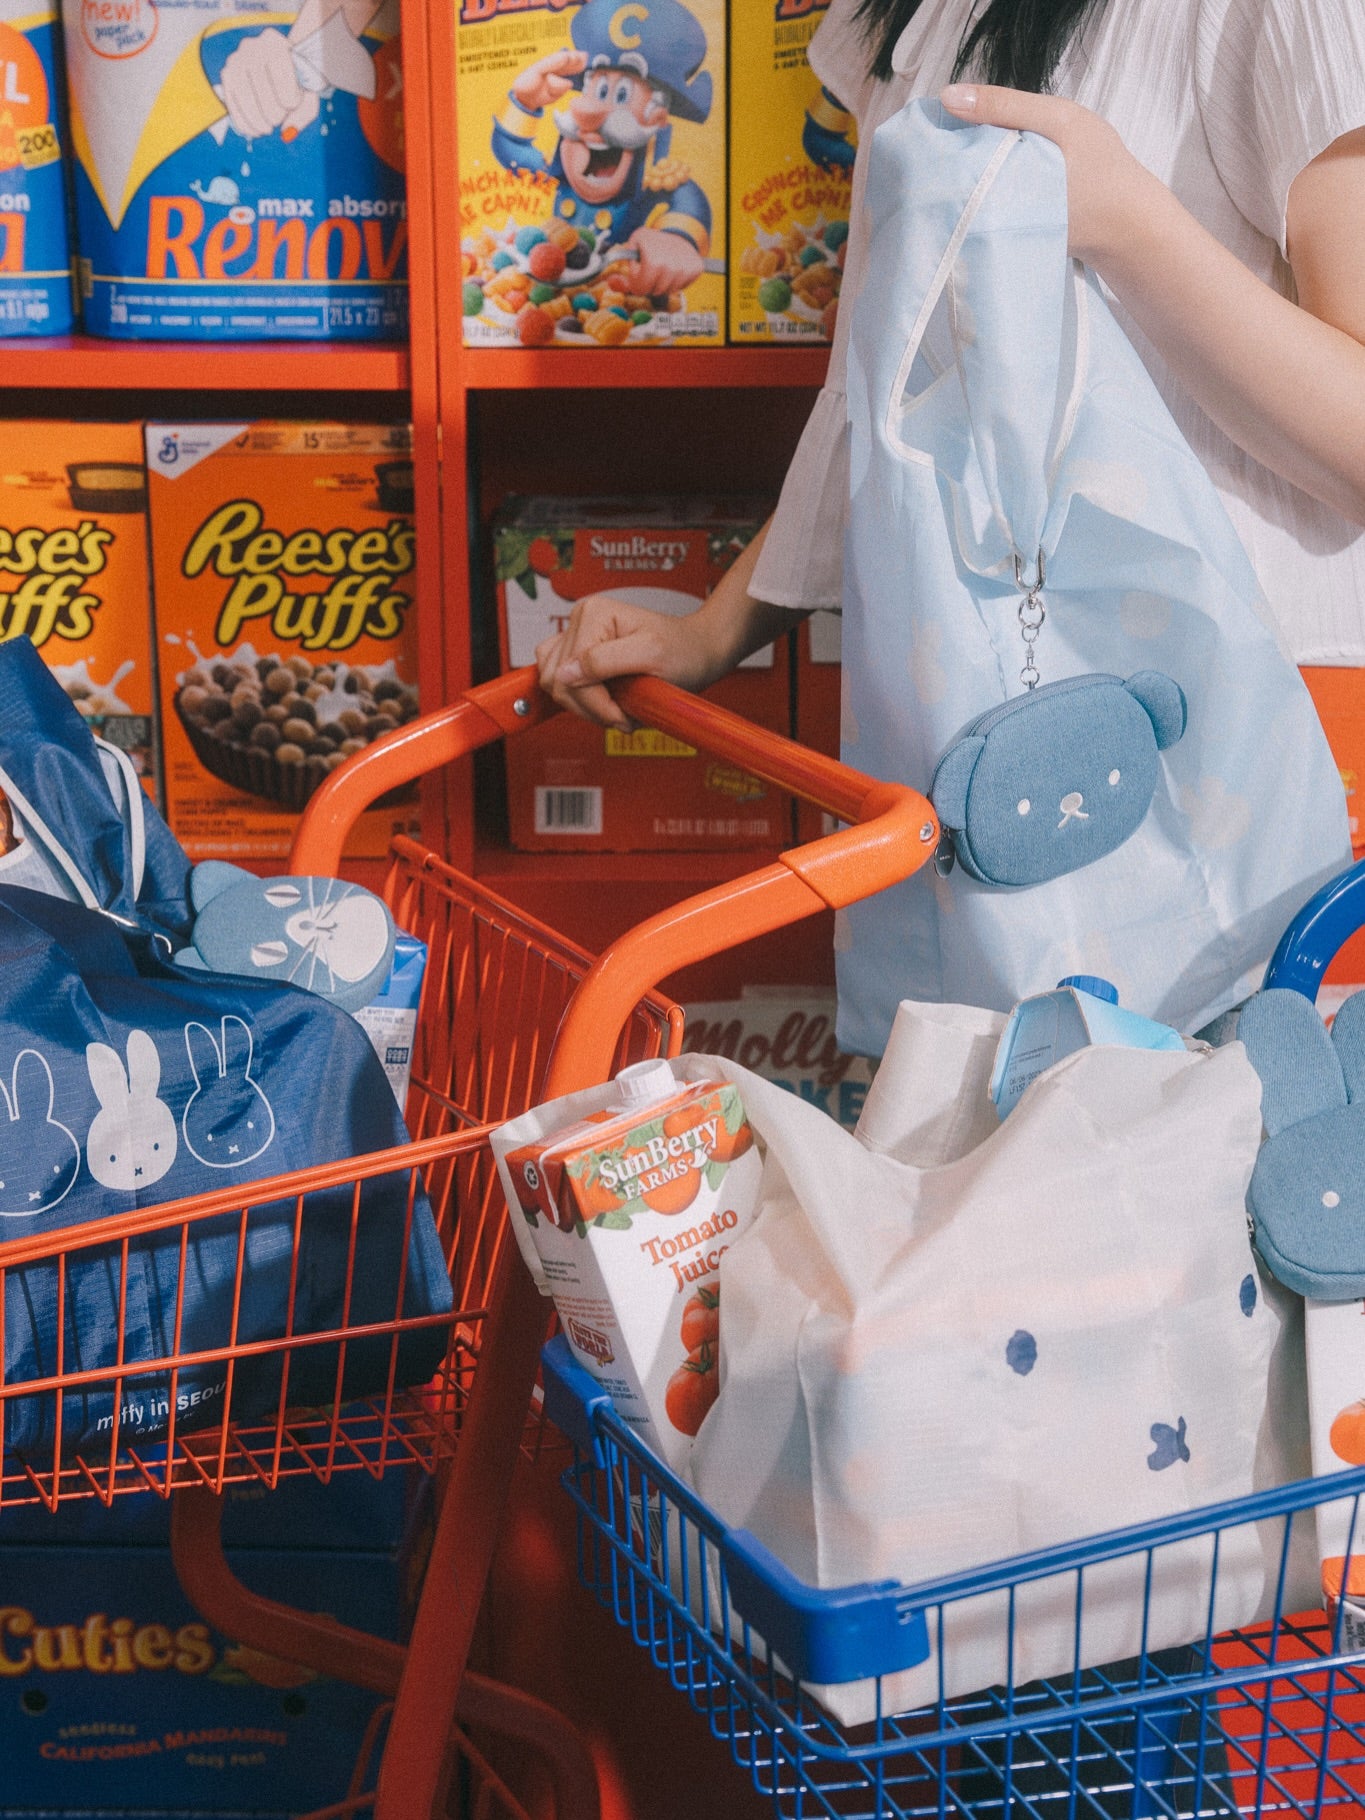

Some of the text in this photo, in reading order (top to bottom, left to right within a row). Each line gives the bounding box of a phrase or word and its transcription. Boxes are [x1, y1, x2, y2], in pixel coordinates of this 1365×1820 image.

[258, 197, 314, 217] max
[183, 499, 415, 577] Reese's
[590, 535, 690, 564] SunBerry
[0, 572, 102, 650] ffs
[215, 572, 409, 651] Puffs
[599, 1117, 719, 1189] SunBerry
[623, 1158, 689, 1201] FARMS
[640, 1208, 738, 1266] Tomato
[97, 1403, 144, 1431] mffy
[151, 1398, 169, 1417] in
[177, 1381, 227, 1412] SEOU
[0, 1606, 215, 1678] Cuties
[39, 1740, 162, 1761] CALIFORNIA
